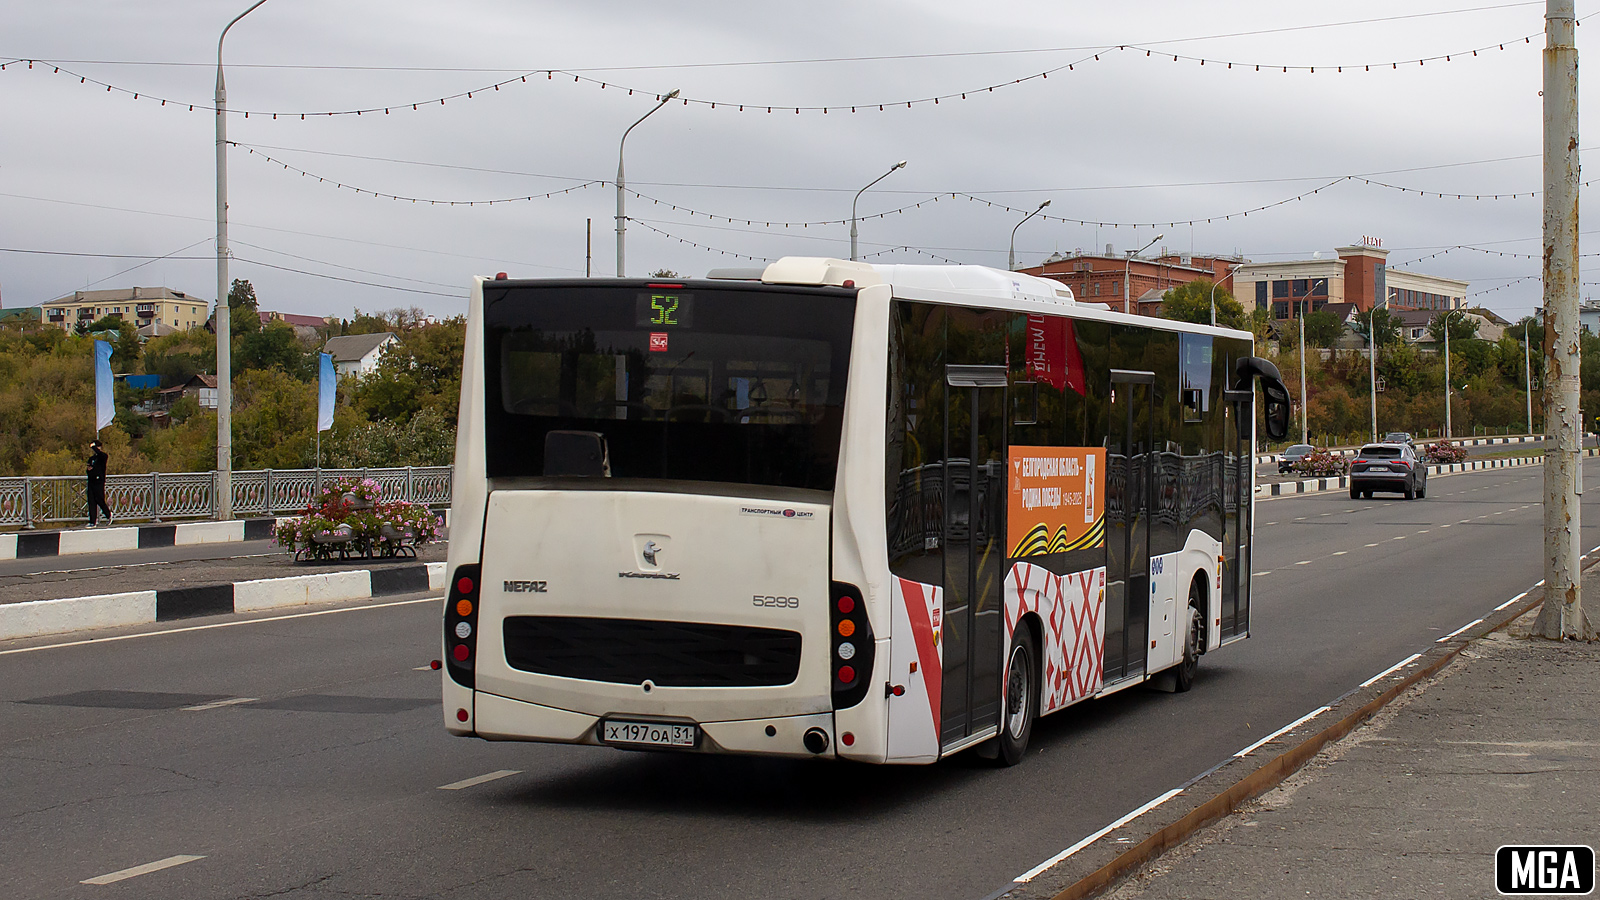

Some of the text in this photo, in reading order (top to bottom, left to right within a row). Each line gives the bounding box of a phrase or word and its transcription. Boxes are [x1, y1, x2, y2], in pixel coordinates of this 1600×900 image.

[1362, 234, 1384, 248] ТЕАТР
[650, 294, 679, 325] 52
[1022, 457, 1059, 480] БЕЛГОРОДСКАЯ
[1059, 457, 1079, 477] ОБЛАСТЬ
[1022, 487, 1083, 511] РОДИНА ПОБЕДЫ 1945-2025
[741, 507, 782, 515] ТРАНСПОРТНЫЙ
[503, 580, 548, 593] NEFAZ
[752, 594, 800, 609] 5299
